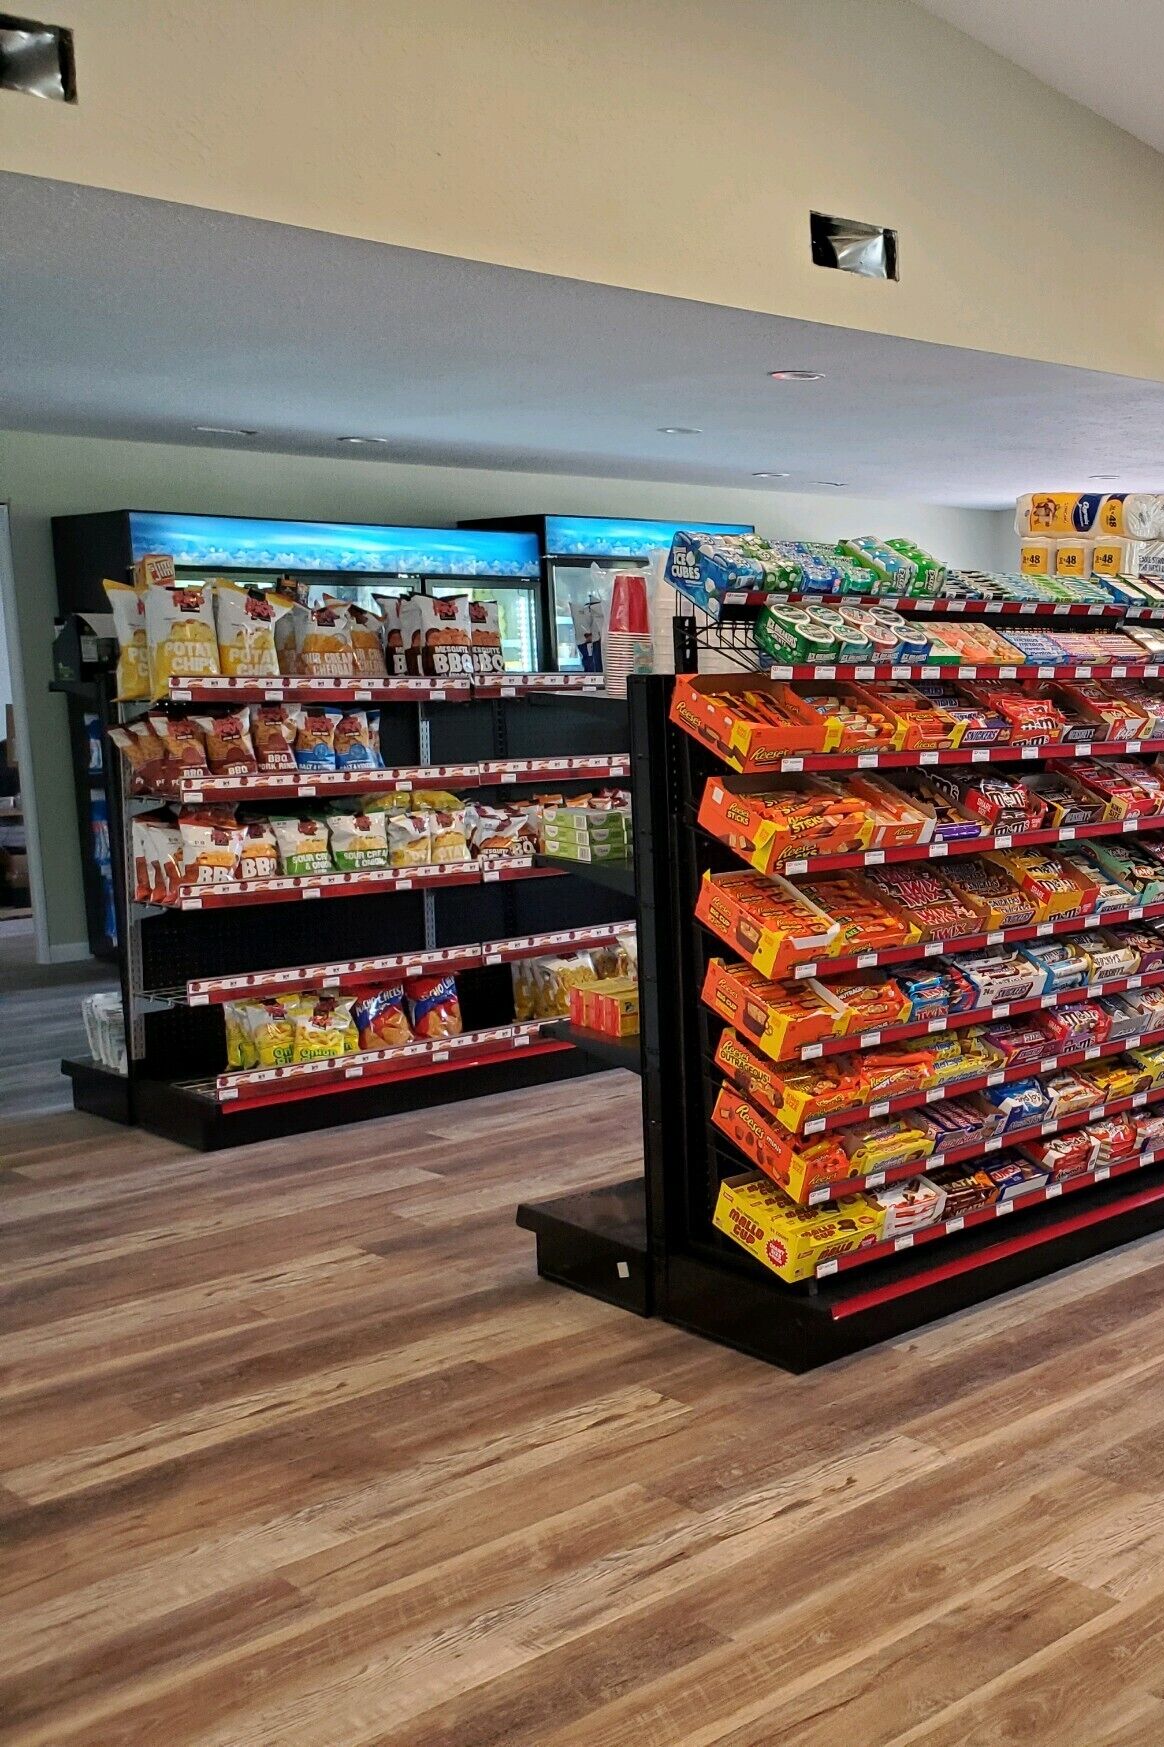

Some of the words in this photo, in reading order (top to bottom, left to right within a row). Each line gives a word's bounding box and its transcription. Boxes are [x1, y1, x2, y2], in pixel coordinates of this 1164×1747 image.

[672, 551, 687, 566] ICE
[1029, 555, 1040, 564] 48
[1066, 556, 1077, 565] 48
[1102, 554, 1113, 564] 48
[671, 566, 701, 581] CUBES
[433, 652, 473, 674] BBQ
[964, 730, 998, 742] SNICKERS
[267, 753, 288, 763] BBQ
[228, 764, 248, 775] BBQ
[726, 811, 750, 827] STICKS
[792, 815, 824, 833] STICKS
[343, 851, 364, 862] SOUR
[929, 923, 967, 942] TWIX
[720, 1049, 771, 1083] OUTRAGEOUS!
[735, 1104, 765, 1139] Reese's
[728, 1207, 765, 1242] MALLO
[732, 1223, 756, 1246] CUP
[814, 1229, 836, 1241] CUP
